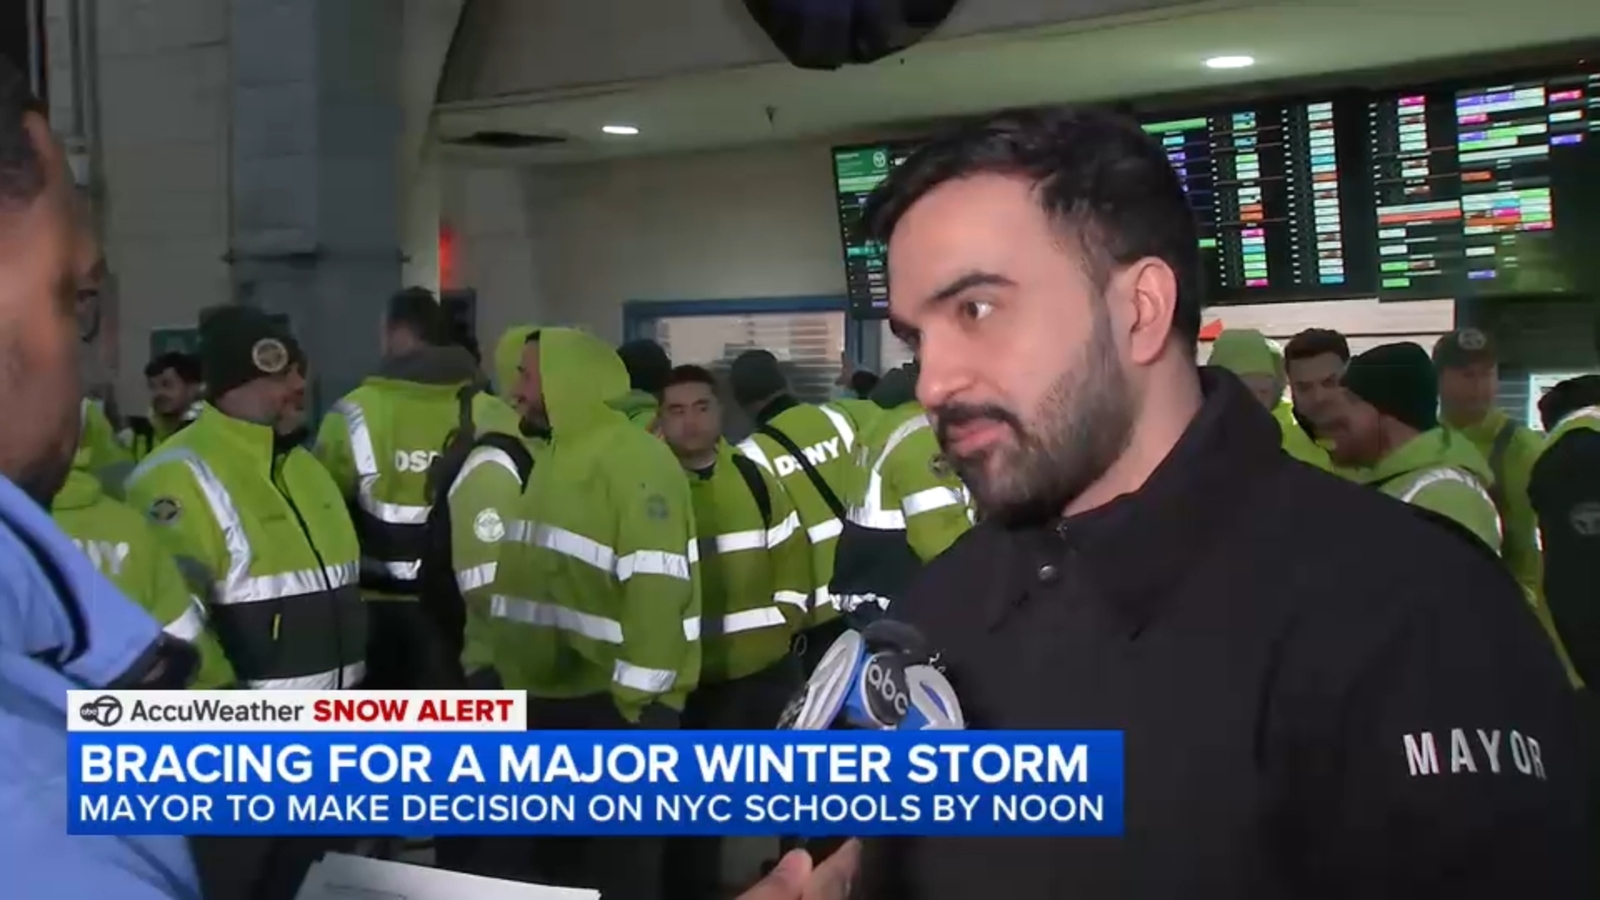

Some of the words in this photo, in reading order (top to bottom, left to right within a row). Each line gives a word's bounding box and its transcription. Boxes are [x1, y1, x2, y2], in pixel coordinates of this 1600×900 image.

[395, 449, 442, 473] DS
[867, 662, 909, 716] abc
[1403, 728, 1547, 780] MAYOR
